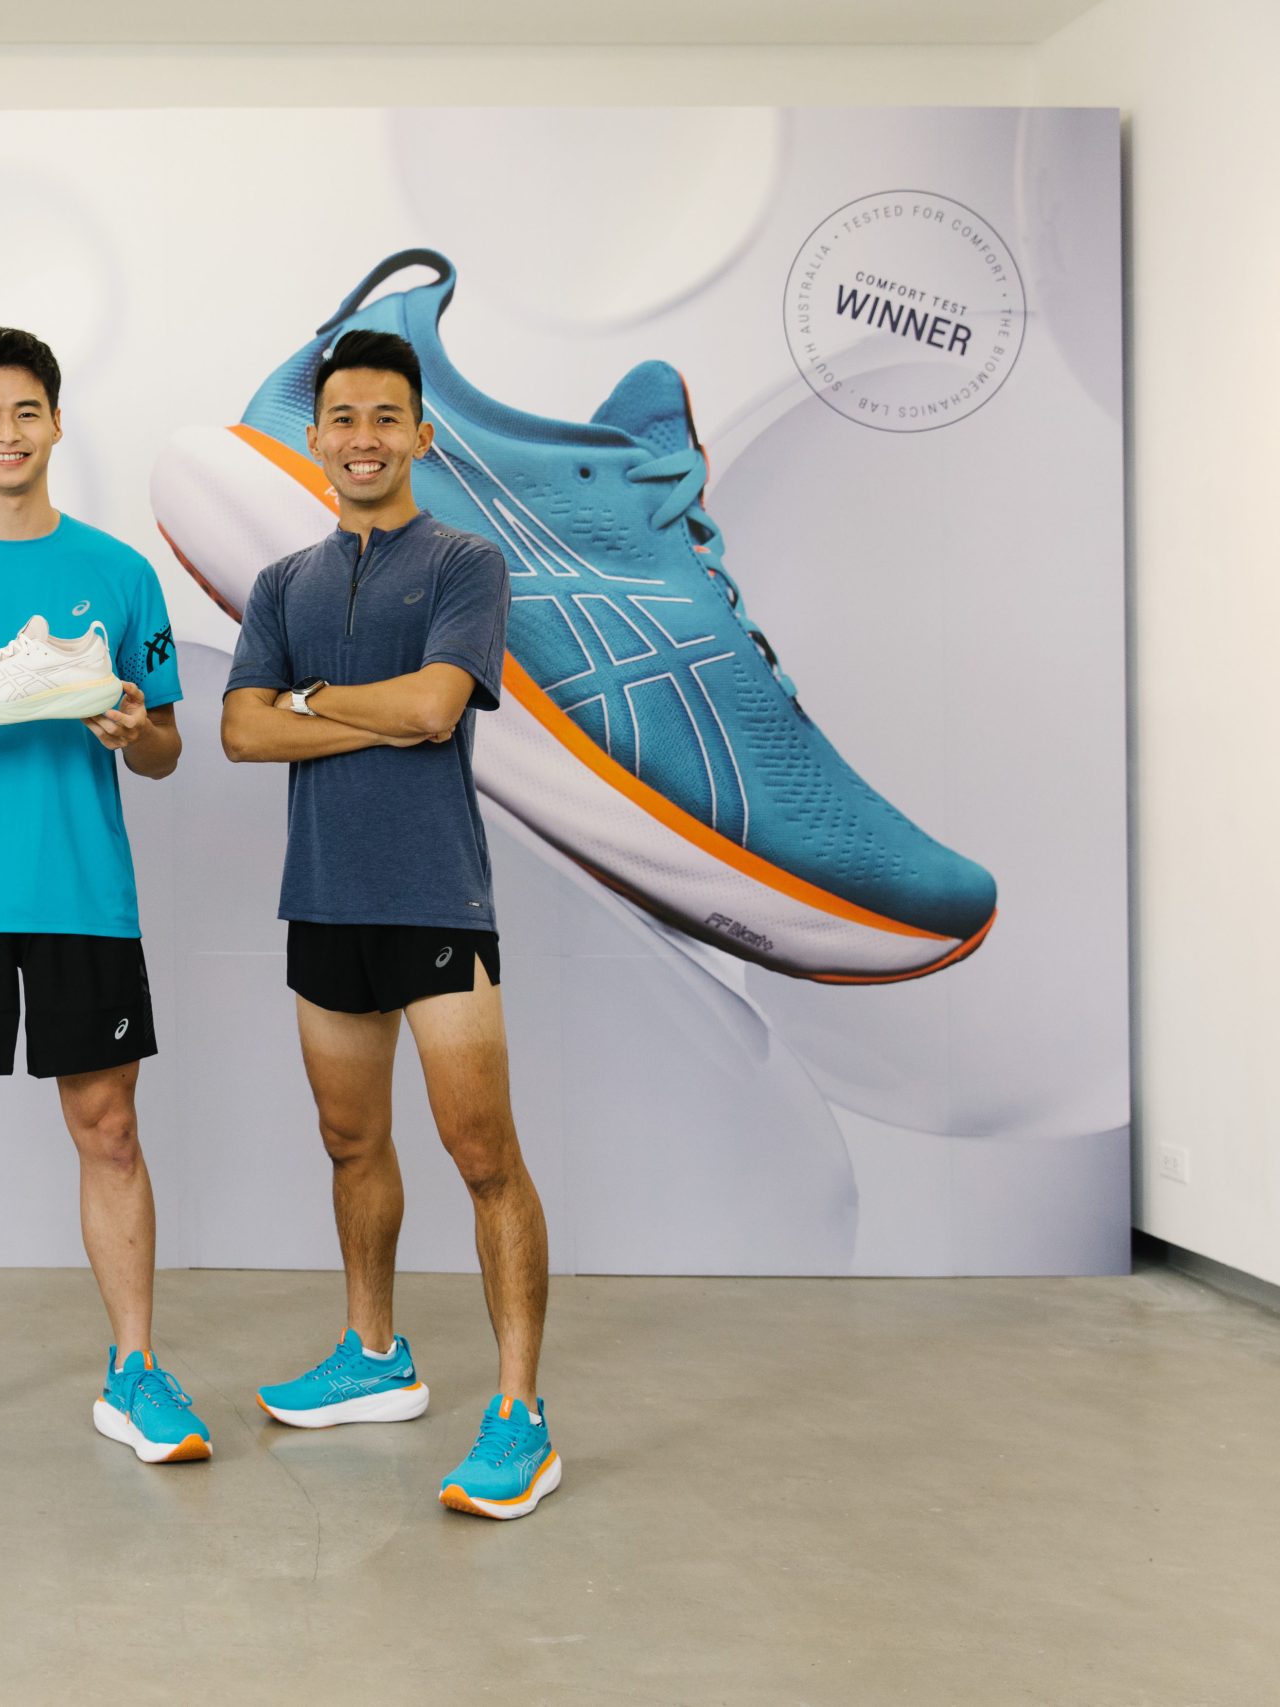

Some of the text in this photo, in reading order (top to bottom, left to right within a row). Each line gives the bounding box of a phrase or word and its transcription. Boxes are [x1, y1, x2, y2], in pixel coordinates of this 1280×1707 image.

[842, 205, 1008, 285] TESTED FOR COMFORT
[797, 245, 843, 393] SOUTH AUSTRALIA
[835, 284, 973, 357] WINNER
[855, 271, 969, 317] COMFORT TEST
[858, 308, 1012, 418] THE BIOMECHANICS LAB
